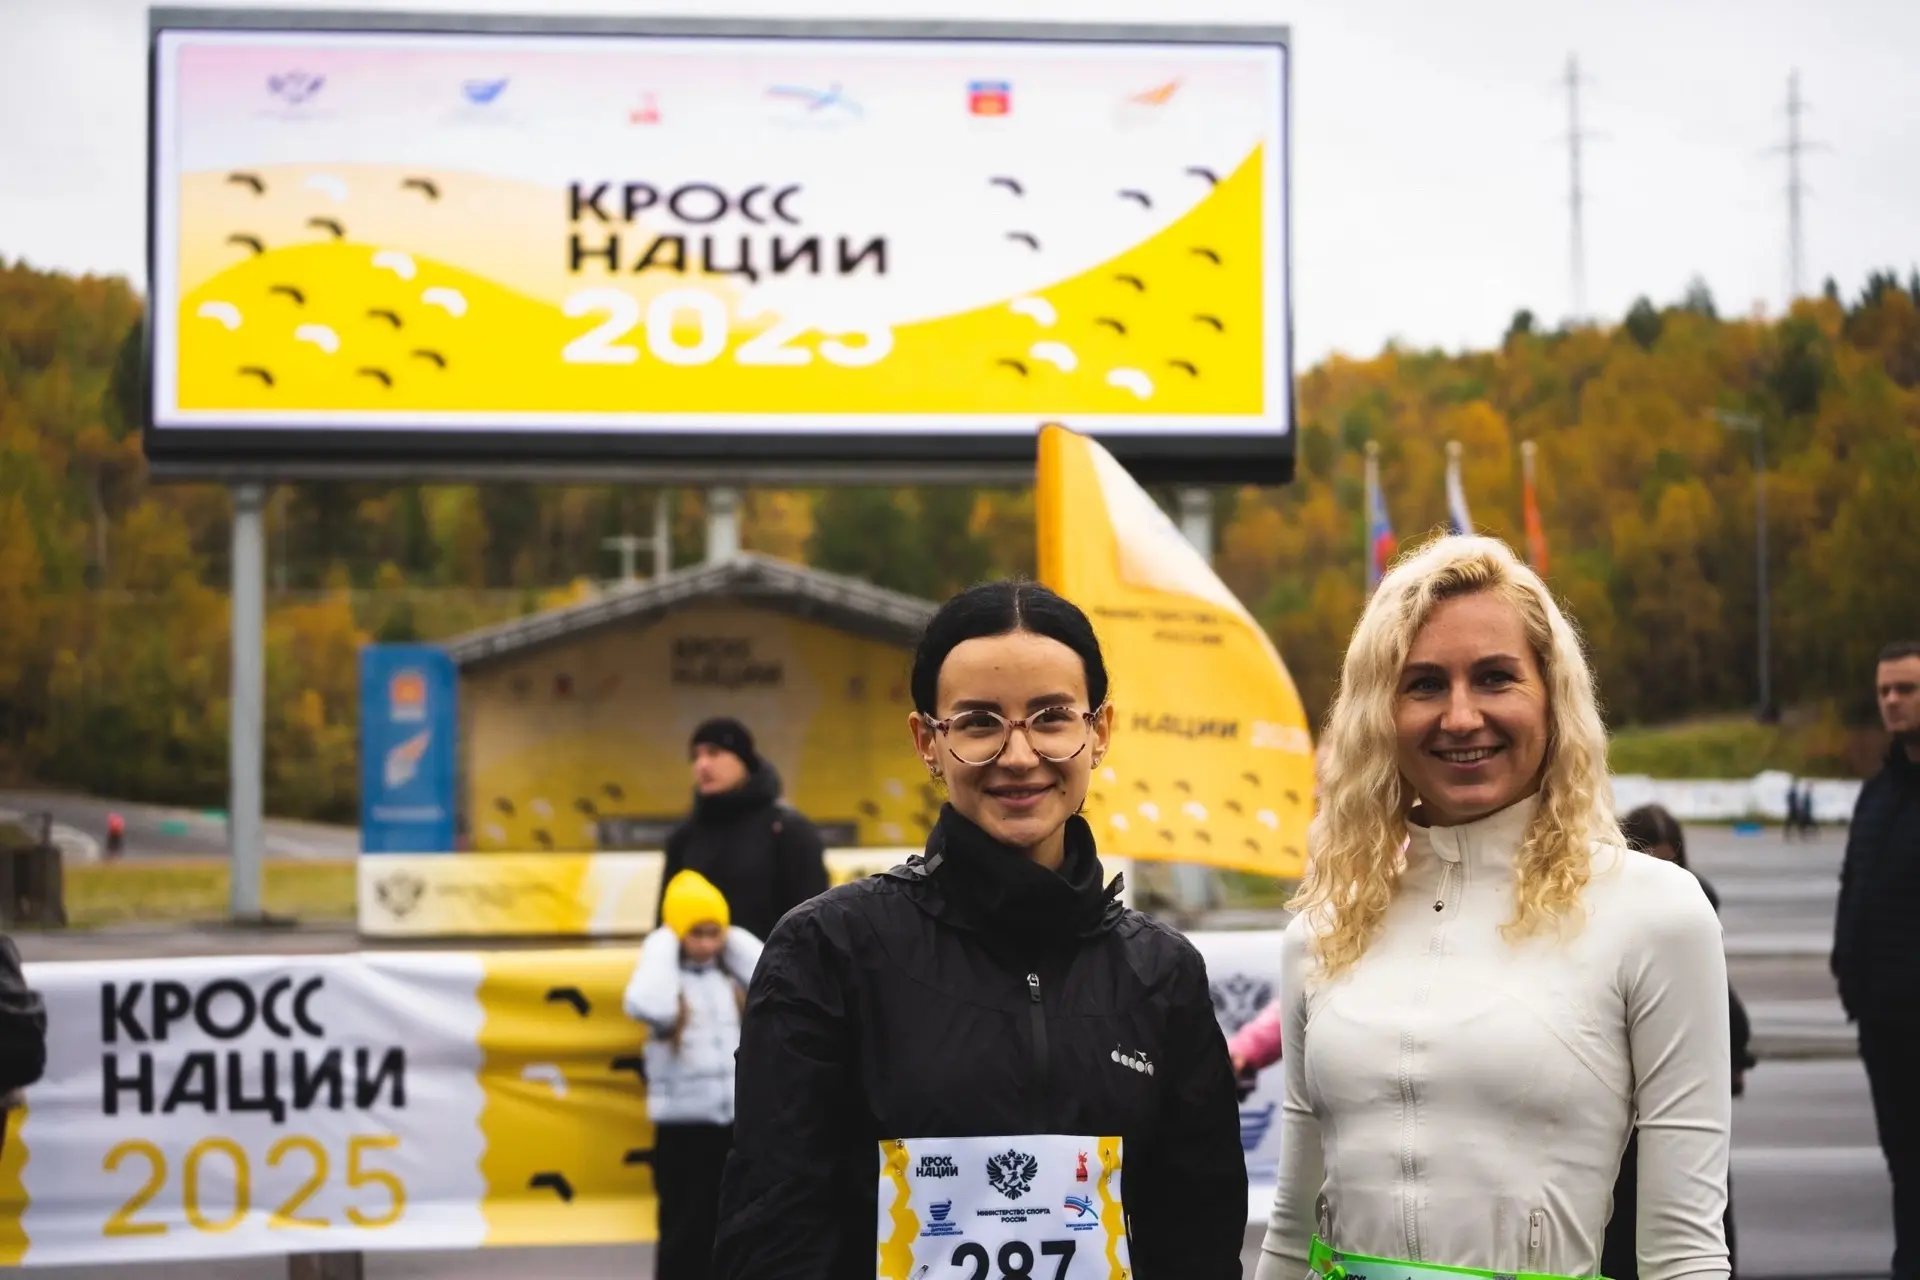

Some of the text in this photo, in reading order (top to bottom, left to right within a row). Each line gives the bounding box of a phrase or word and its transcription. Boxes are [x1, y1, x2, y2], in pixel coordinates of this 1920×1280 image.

[568, 180, 803, 225] КРОСС
[568, 233, 888, 283] НАЦИИ
[101, 976, 324, 1044] КРОСС
[102, 1045, 406, 1125] НАЦИИ
[915, 1165, 959, 1179] НАЦИИ
[920, 1155, 953, 1167] КРОСС
[101, 1134, 408, 1239] 2025
[976, 1207, 1051, 1217] МИНИСТЕРСТВО СПОРТА
[1000, 1216, 1028, 1224] РОССИИ
[951, 1239, 1077, 1280] 287
